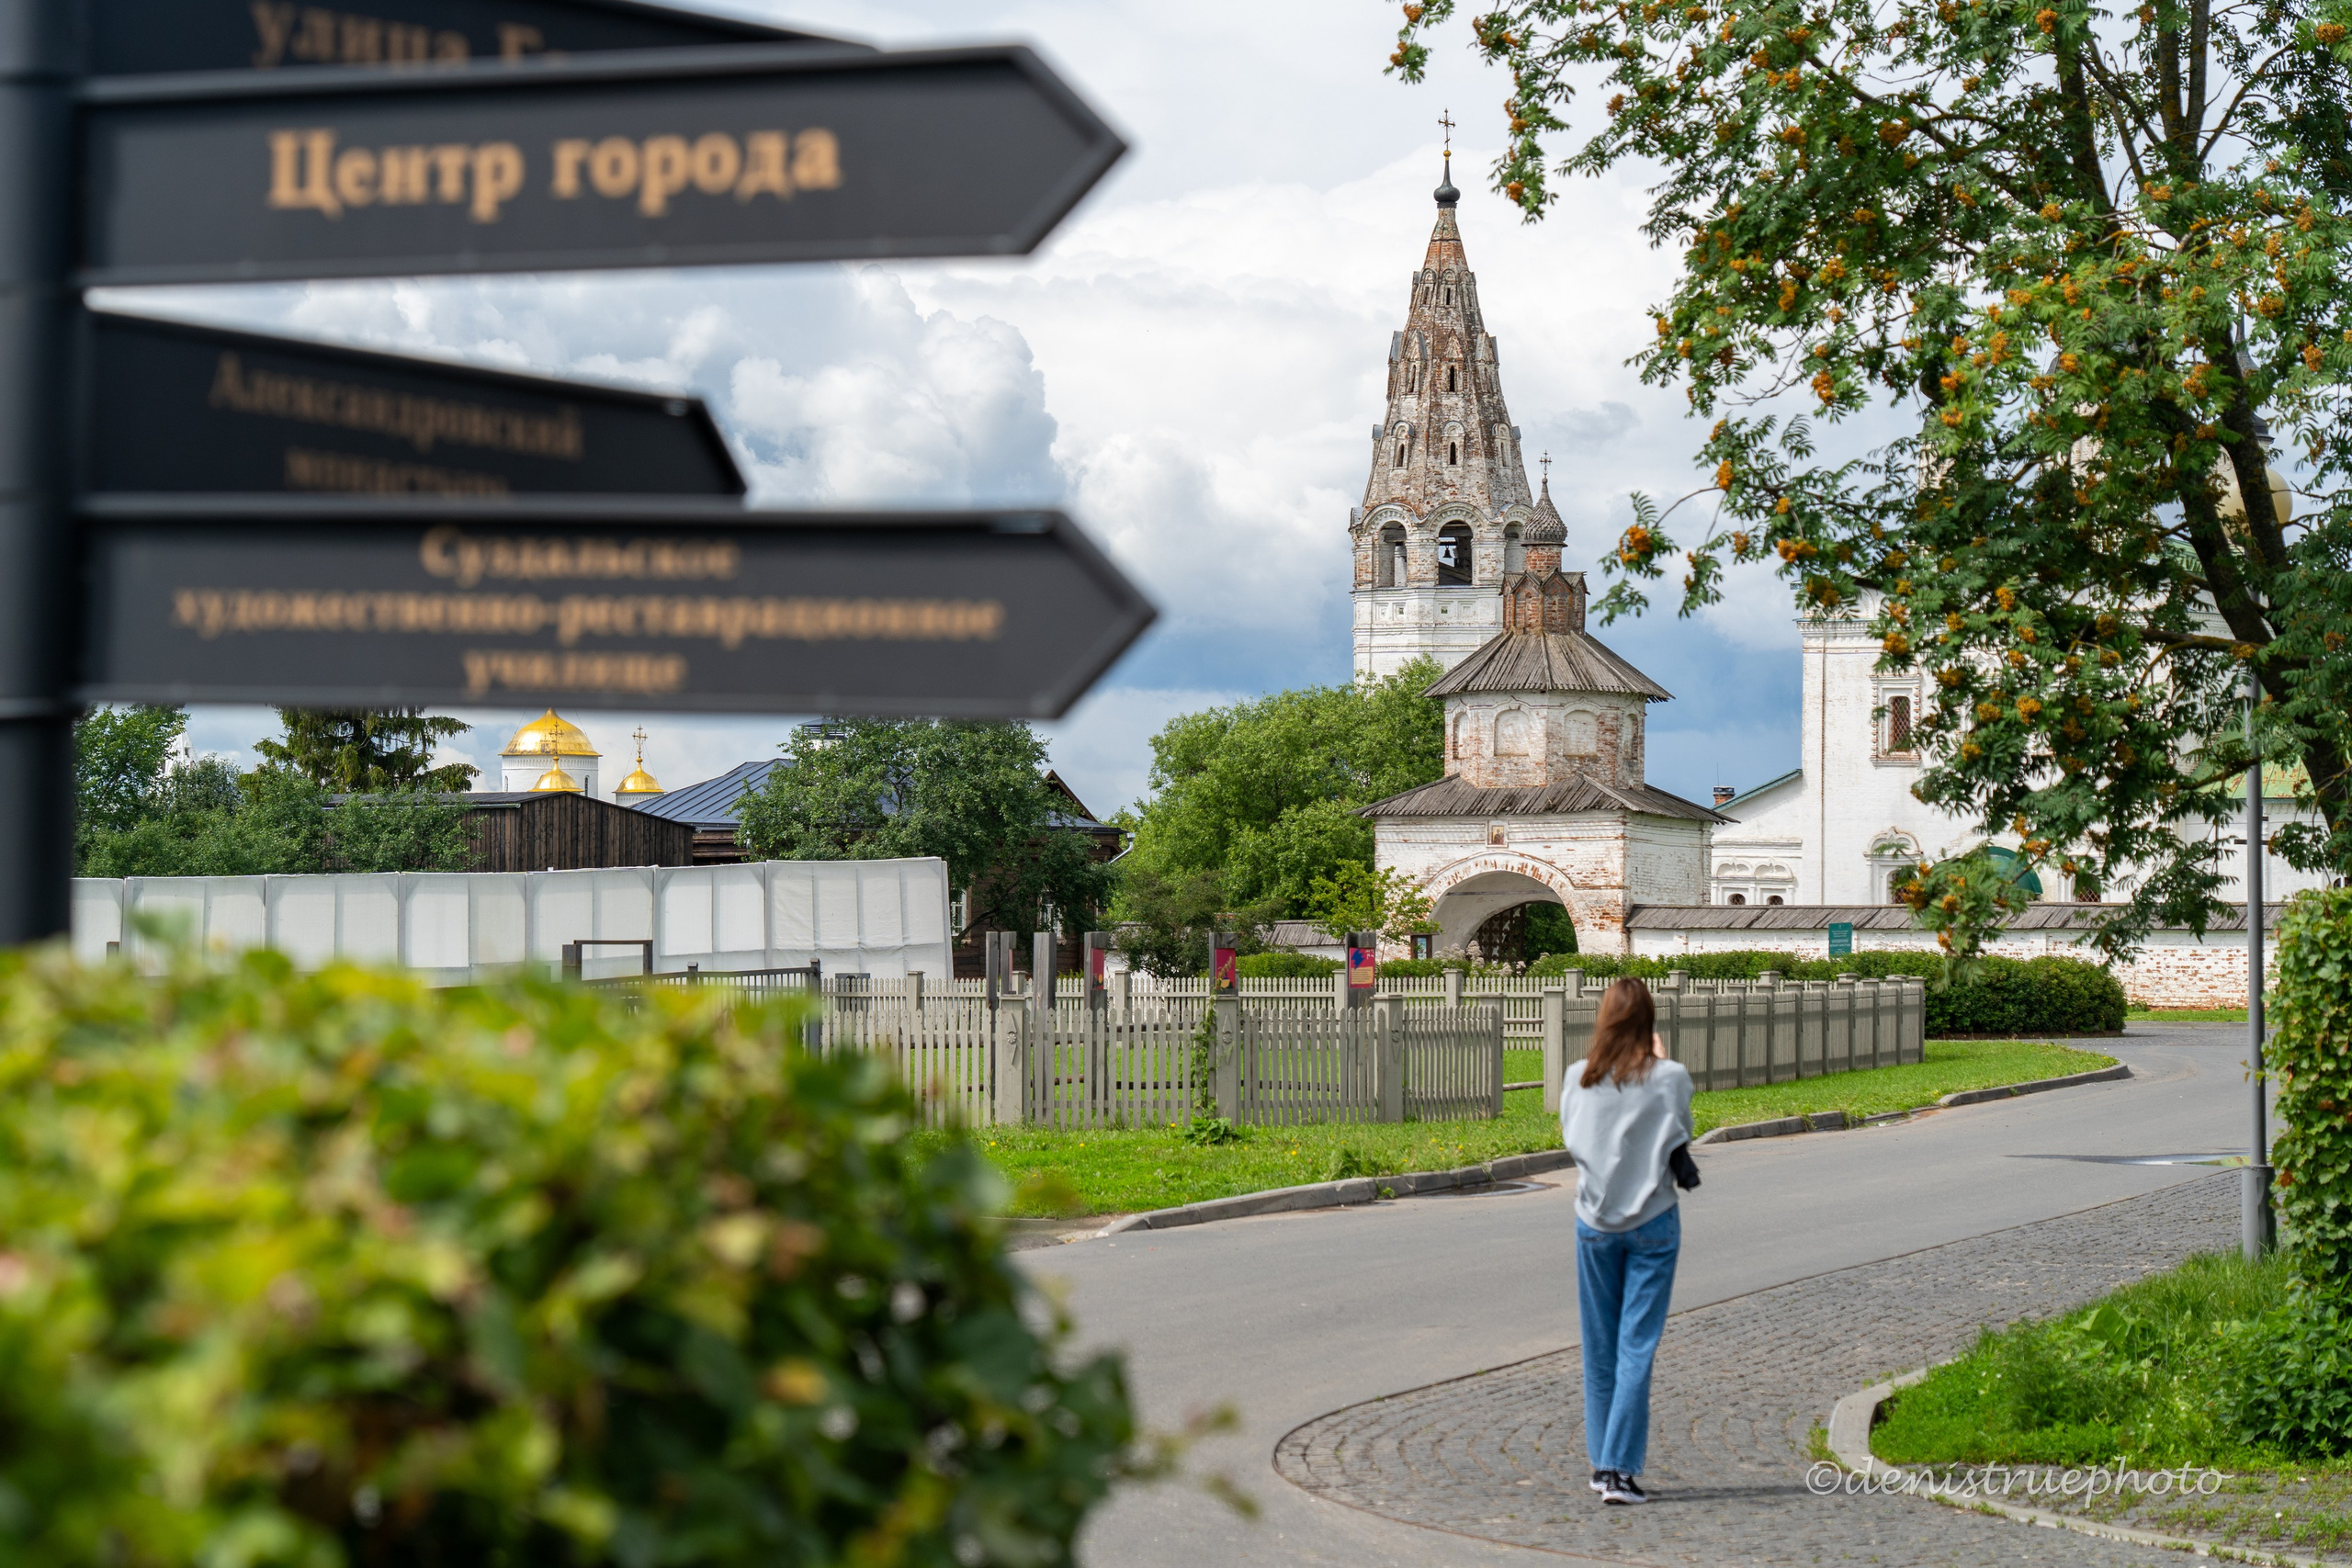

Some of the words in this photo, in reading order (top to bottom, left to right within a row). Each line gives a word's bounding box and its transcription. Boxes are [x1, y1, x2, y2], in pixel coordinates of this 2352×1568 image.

[269, 129, 525, 222] Центр
[552, 127, 840, 217] города
[420, 527, 738, 587] Суздальское
[175, 589, 1002, 649] художественно-реставрационное
[463, 652, 686, 700] училище
